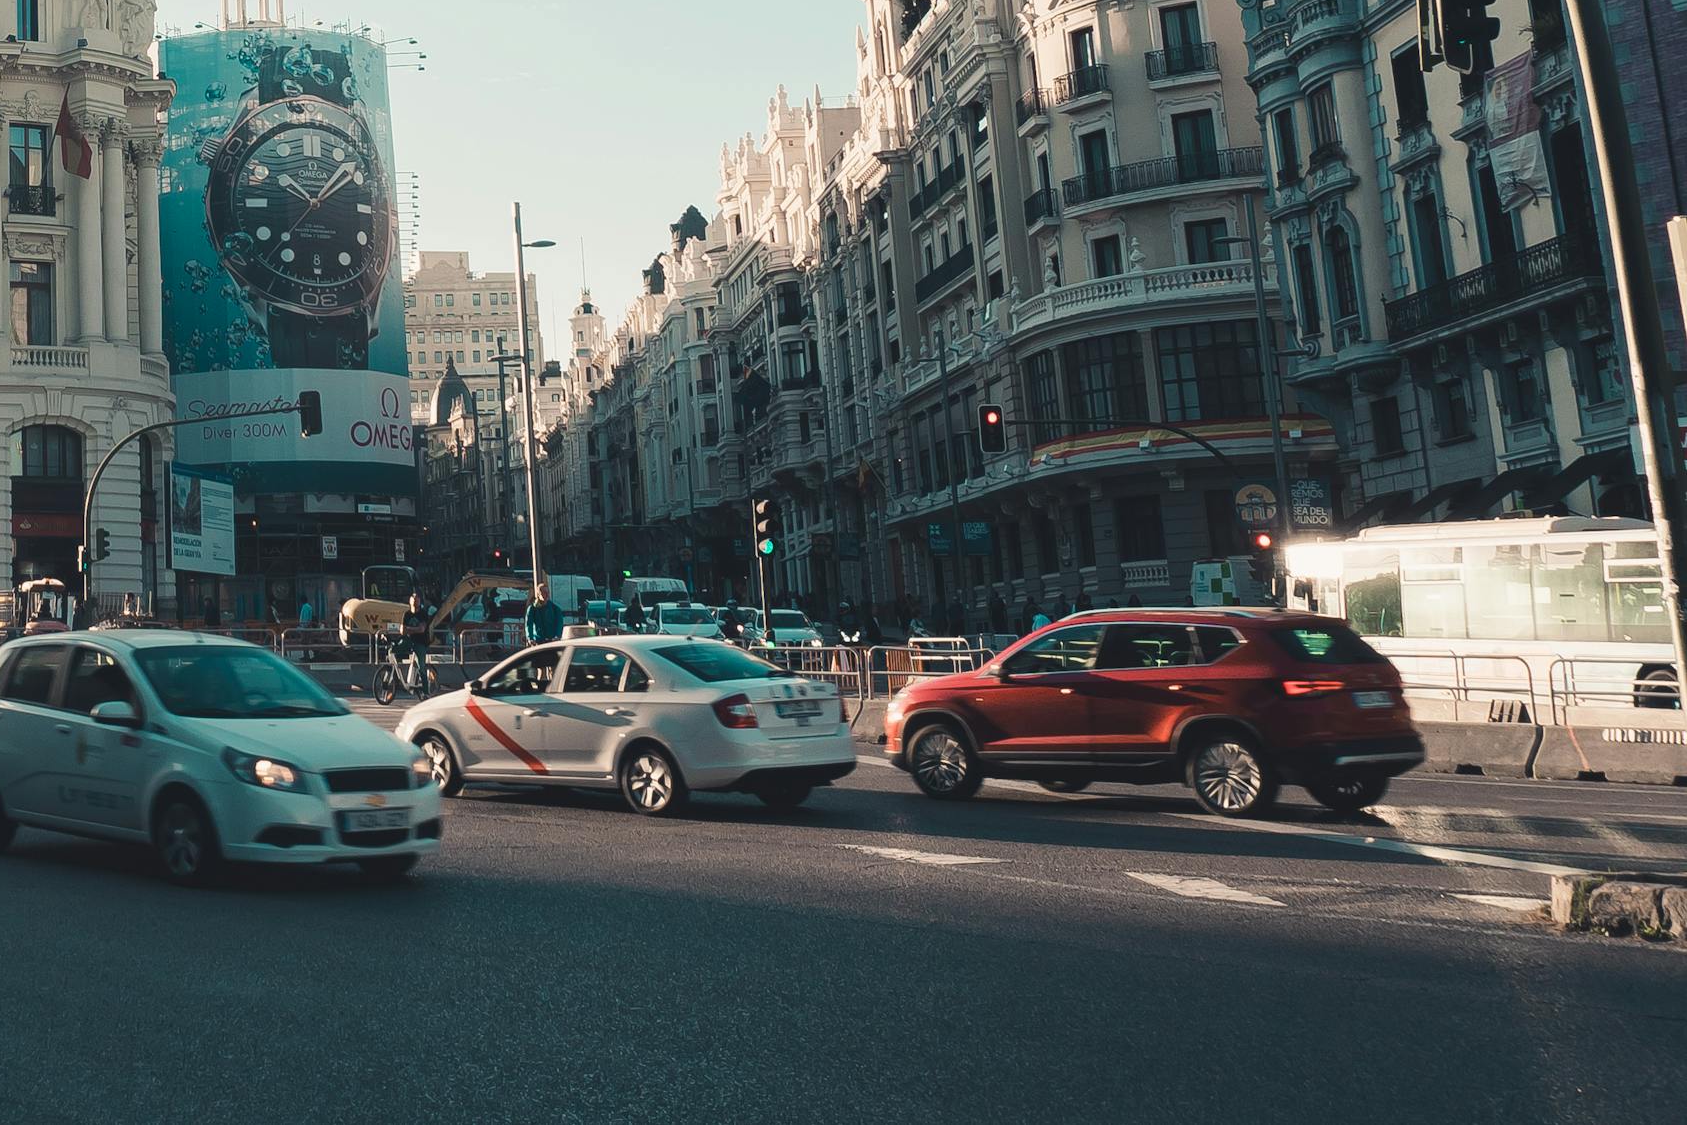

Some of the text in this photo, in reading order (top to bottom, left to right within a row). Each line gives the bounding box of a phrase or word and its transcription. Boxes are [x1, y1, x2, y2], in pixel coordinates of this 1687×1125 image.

[298, 169, 328, 179] OMEGA
[203, 422, 287, 440] Diver 300M
[1292, 498, 1311, 506] QUE
[1293, 506, 1328, 516] SEA DEL
[1293, 515, 1329, 525] MUNDO
